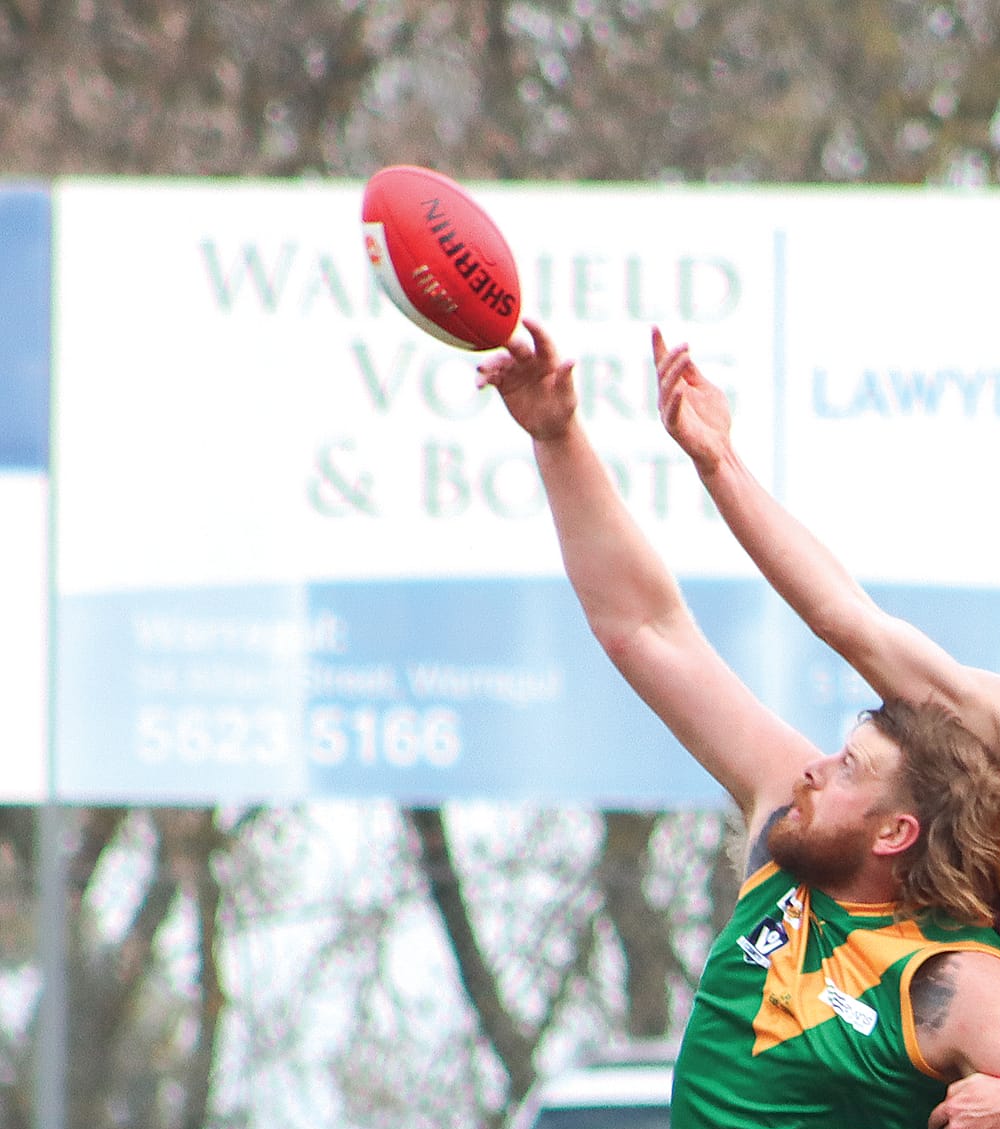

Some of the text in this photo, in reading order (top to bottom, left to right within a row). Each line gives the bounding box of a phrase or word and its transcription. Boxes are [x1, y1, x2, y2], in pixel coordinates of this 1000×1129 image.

[200, 238, 742, 322] WAIELD
[421, 198, 516, 317] SHERRIN
[135, 704, 462, 767] 5623 5166
